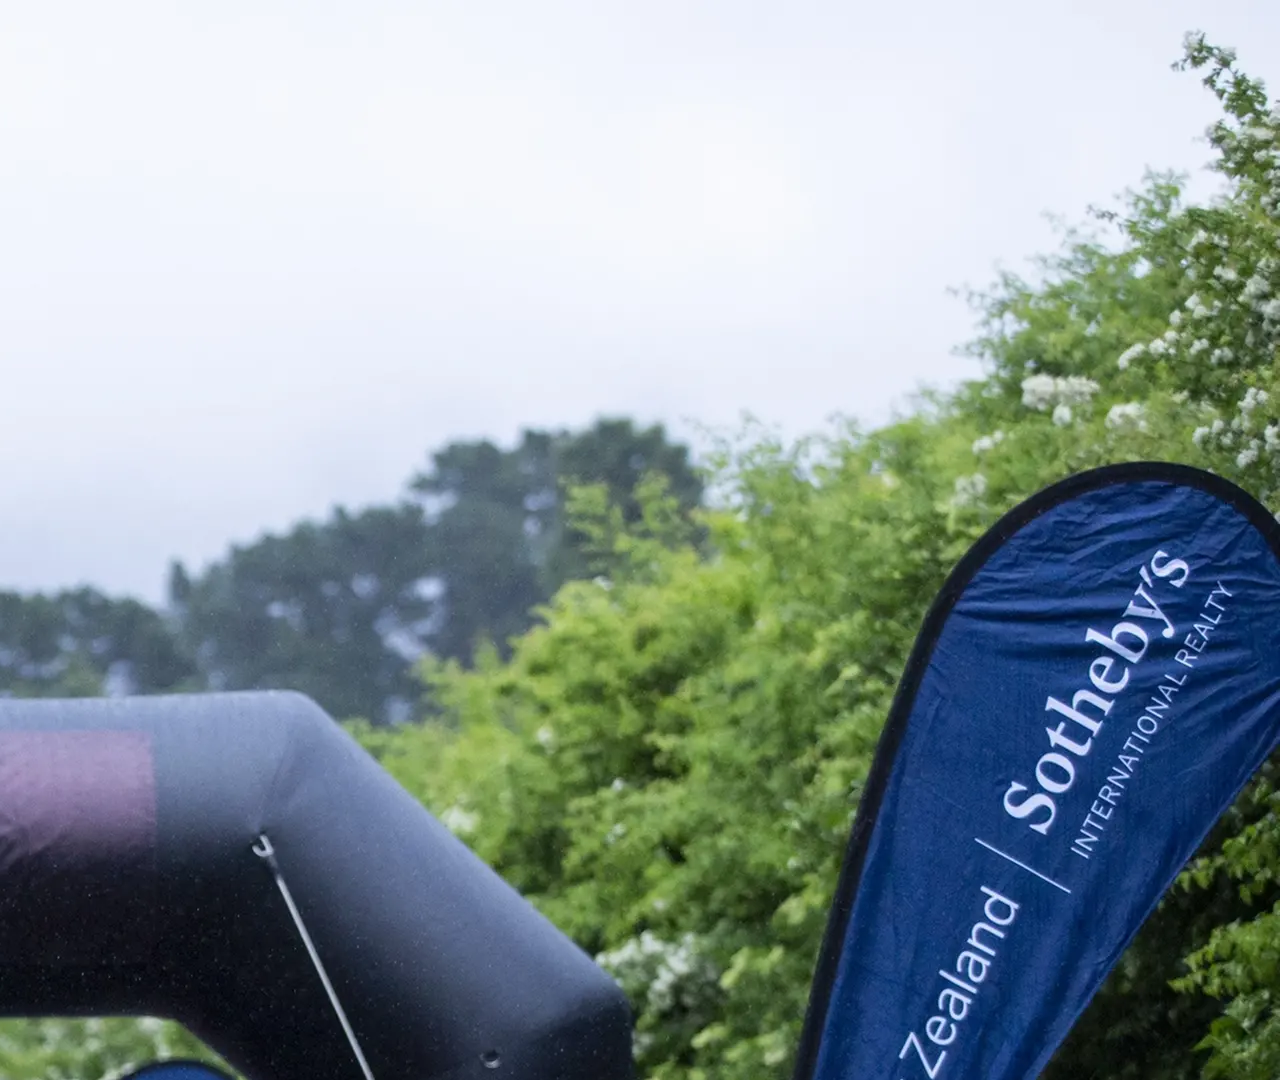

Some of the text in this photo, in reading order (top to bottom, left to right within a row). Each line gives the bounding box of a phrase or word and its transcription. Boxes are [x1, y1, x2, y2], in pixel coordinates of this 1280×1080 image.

[1003, 549, 1192, 836] Sotheby's
[1070, 580, 1234, 859] INTERNATIONAL REALTY
[899, 885, 1021, 1078] Zealand
